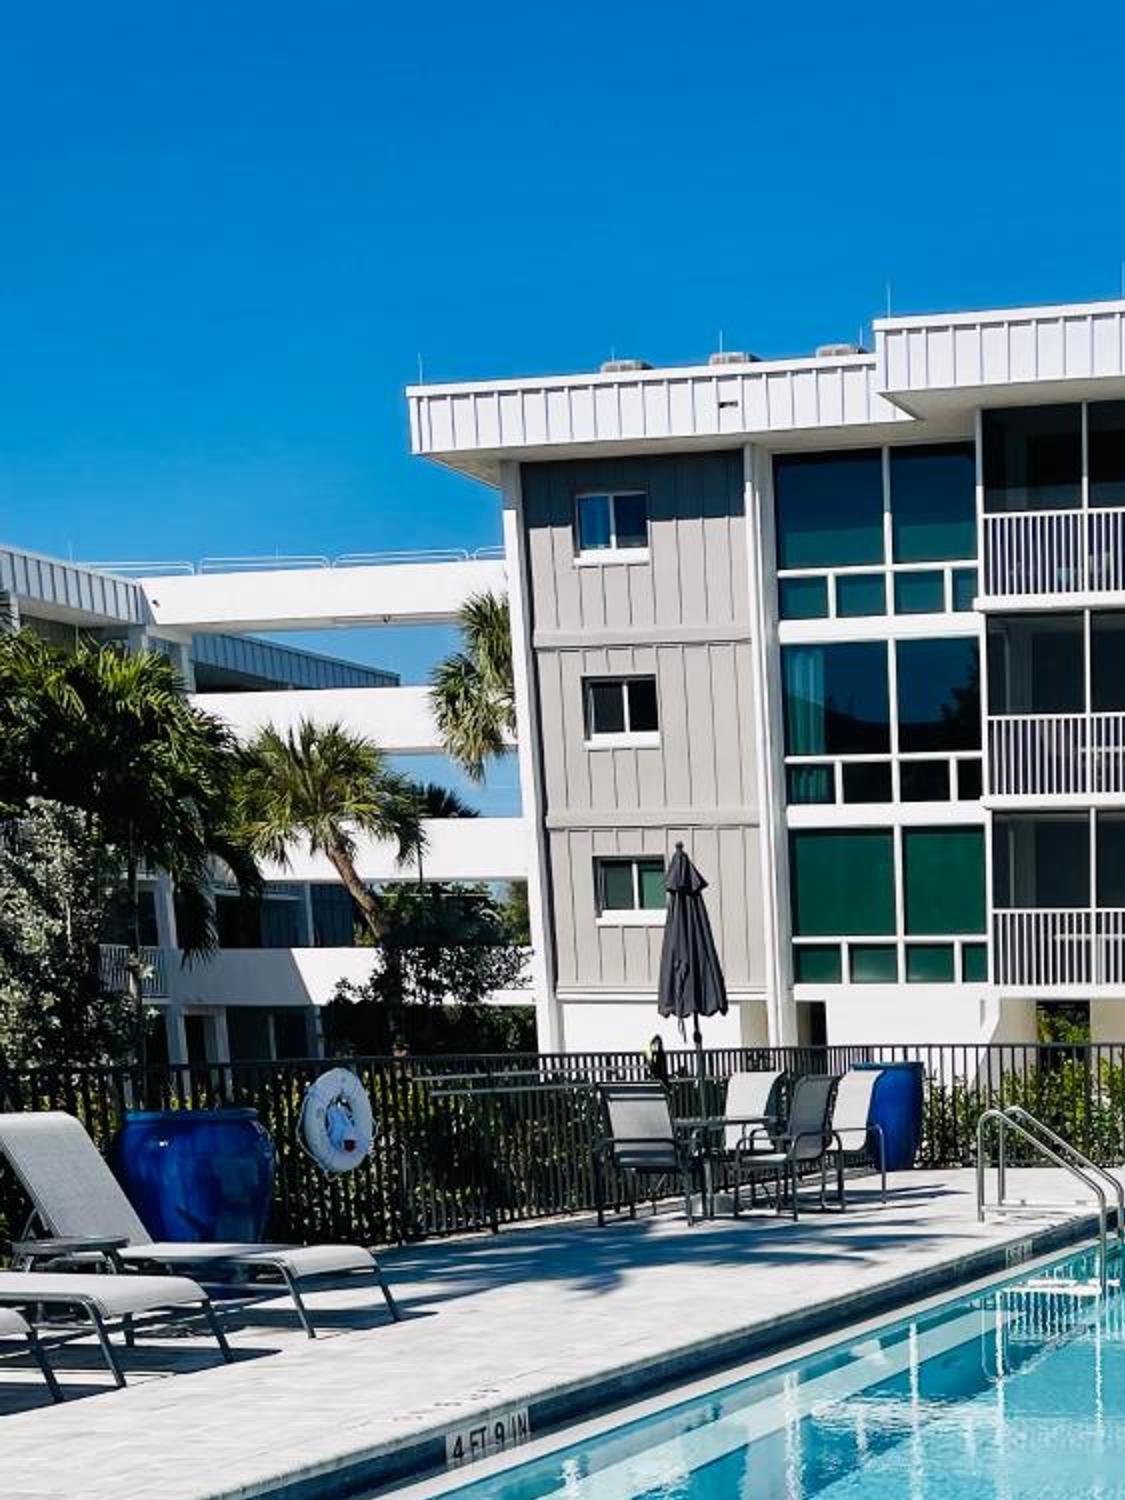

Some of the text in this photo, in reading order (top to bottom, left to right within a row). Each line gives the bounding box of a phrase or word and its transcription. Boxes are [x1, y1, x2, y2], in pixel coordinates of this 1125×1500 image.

[453, 1411, 528, 1458] 4 FT 9 IN
